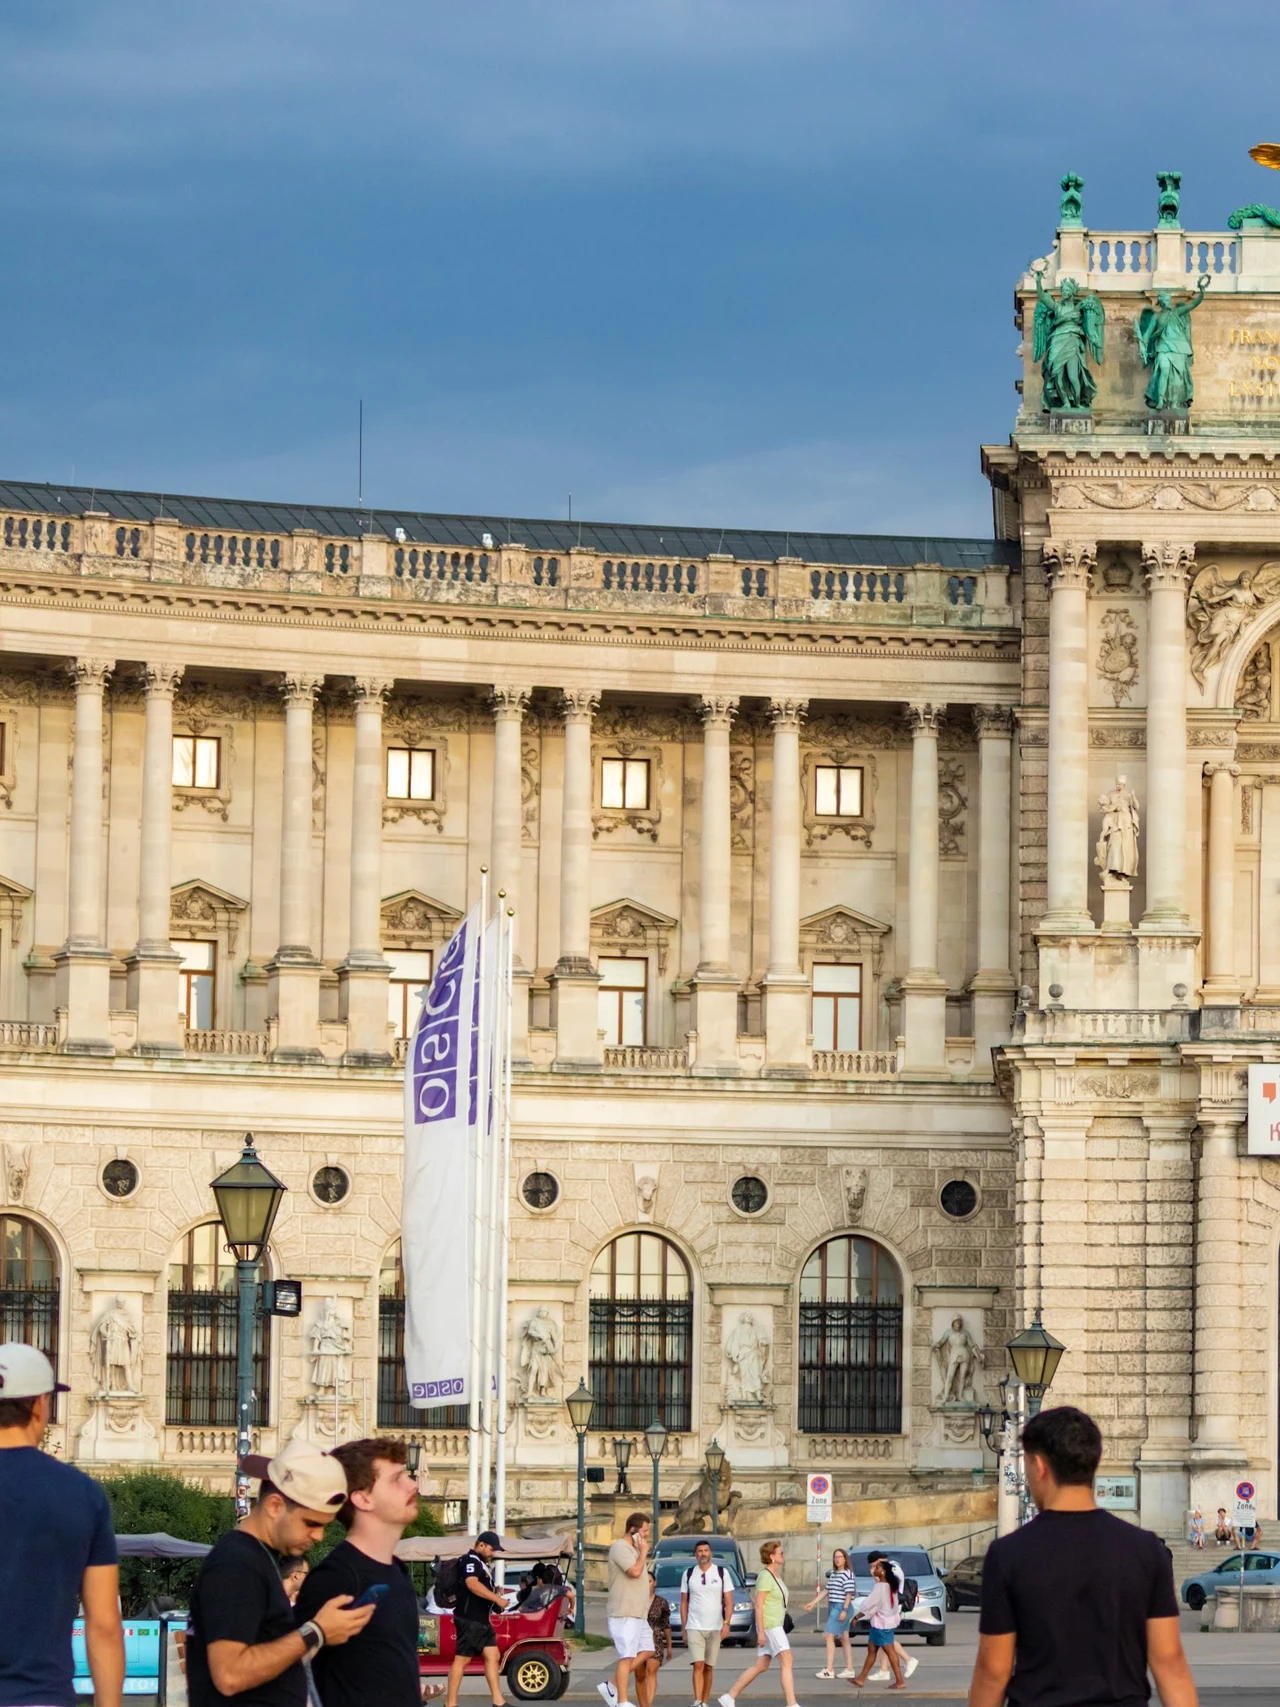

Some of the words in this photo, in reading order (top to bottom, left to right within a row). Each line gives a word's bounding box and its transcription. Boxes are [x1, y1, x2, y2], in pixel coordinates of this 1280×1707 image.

[811, 1495, 828, 1505] Zone
[1236, 1500, 1253, 1510] Zone
[465, 1563, 475, 1573] 5
